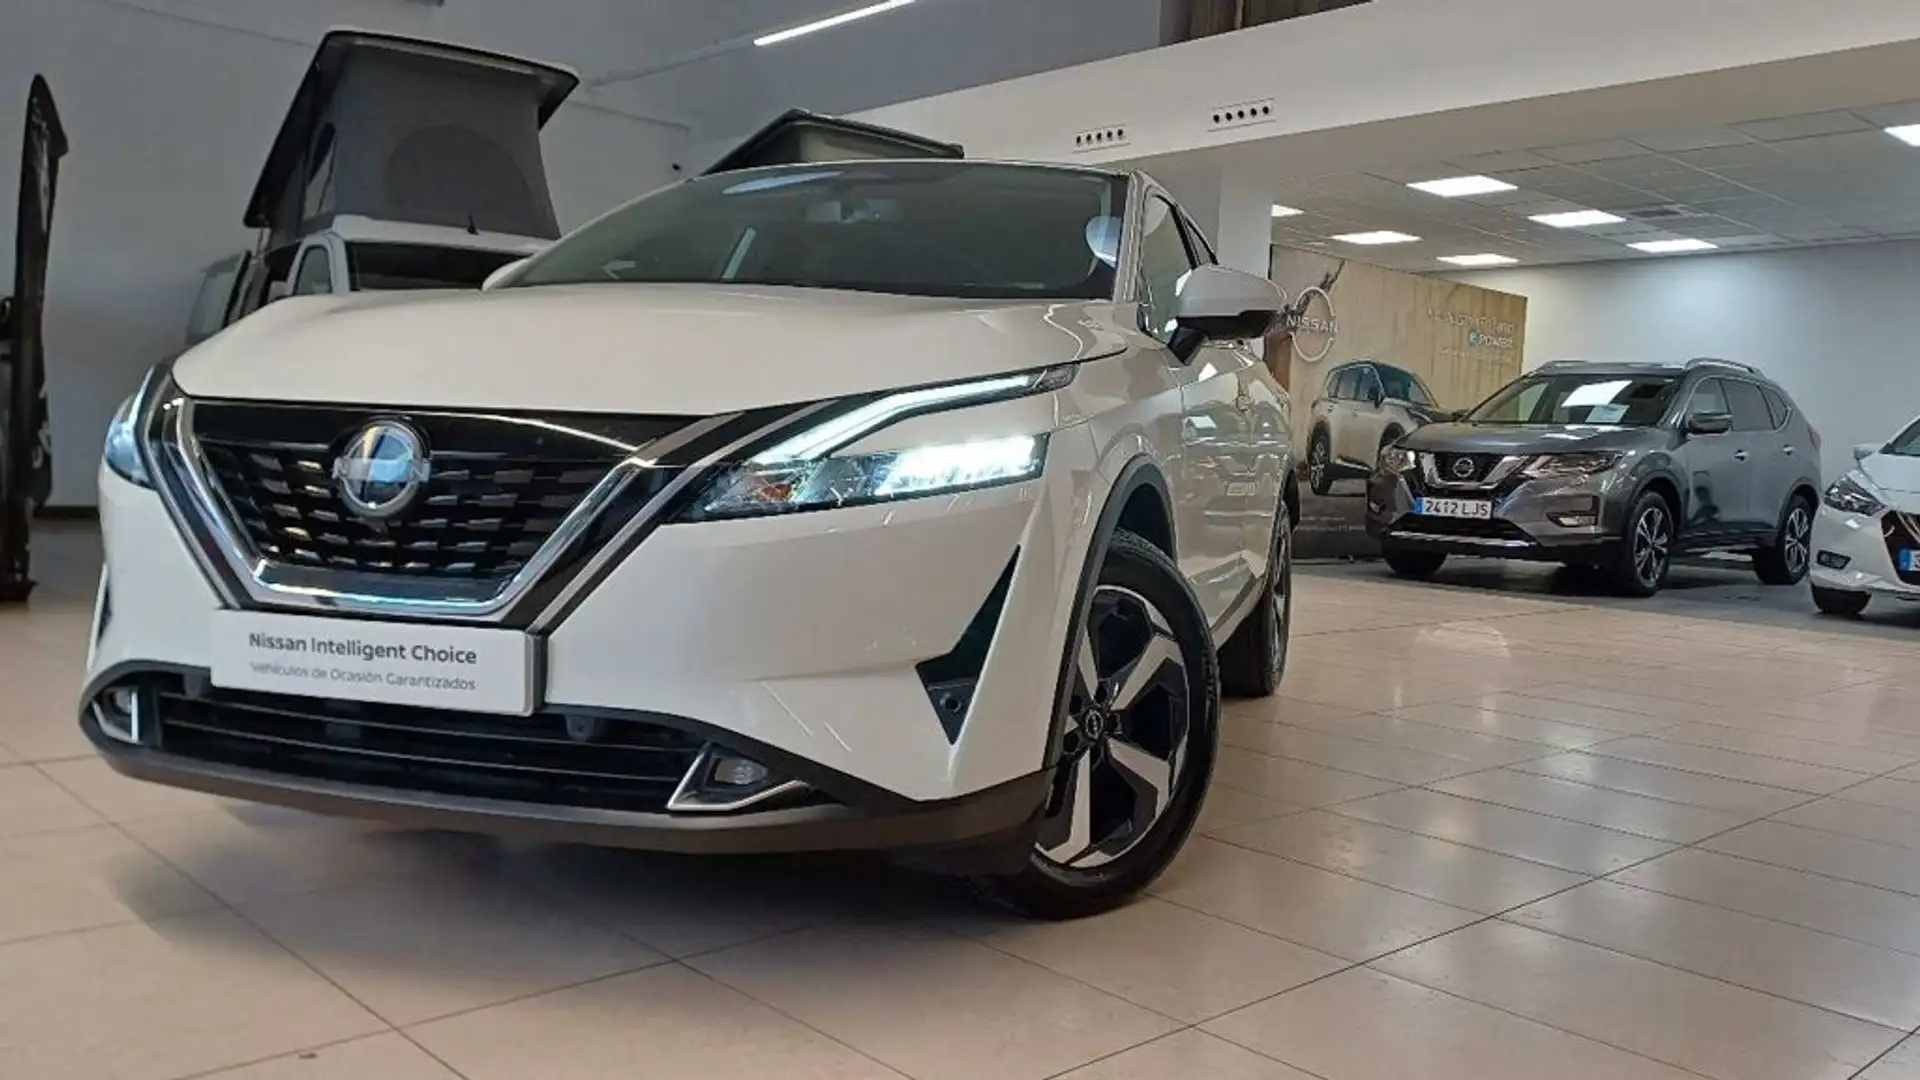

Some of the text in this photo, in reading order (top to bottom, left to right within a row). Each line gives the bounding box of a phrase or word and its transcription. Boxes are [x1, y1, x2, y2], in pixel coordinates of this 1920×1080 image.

[1286, 314, 1338, 334] NISSAN
[1425, 500, 1489, 516] 2412 LJS
[249, 632, 477, 664] Nissan Intelligent Choice
[311, 667, 328, 679] de
[330, 668, 383, 683] Ocasión
[386, 672, 476, 691] Garantizados
